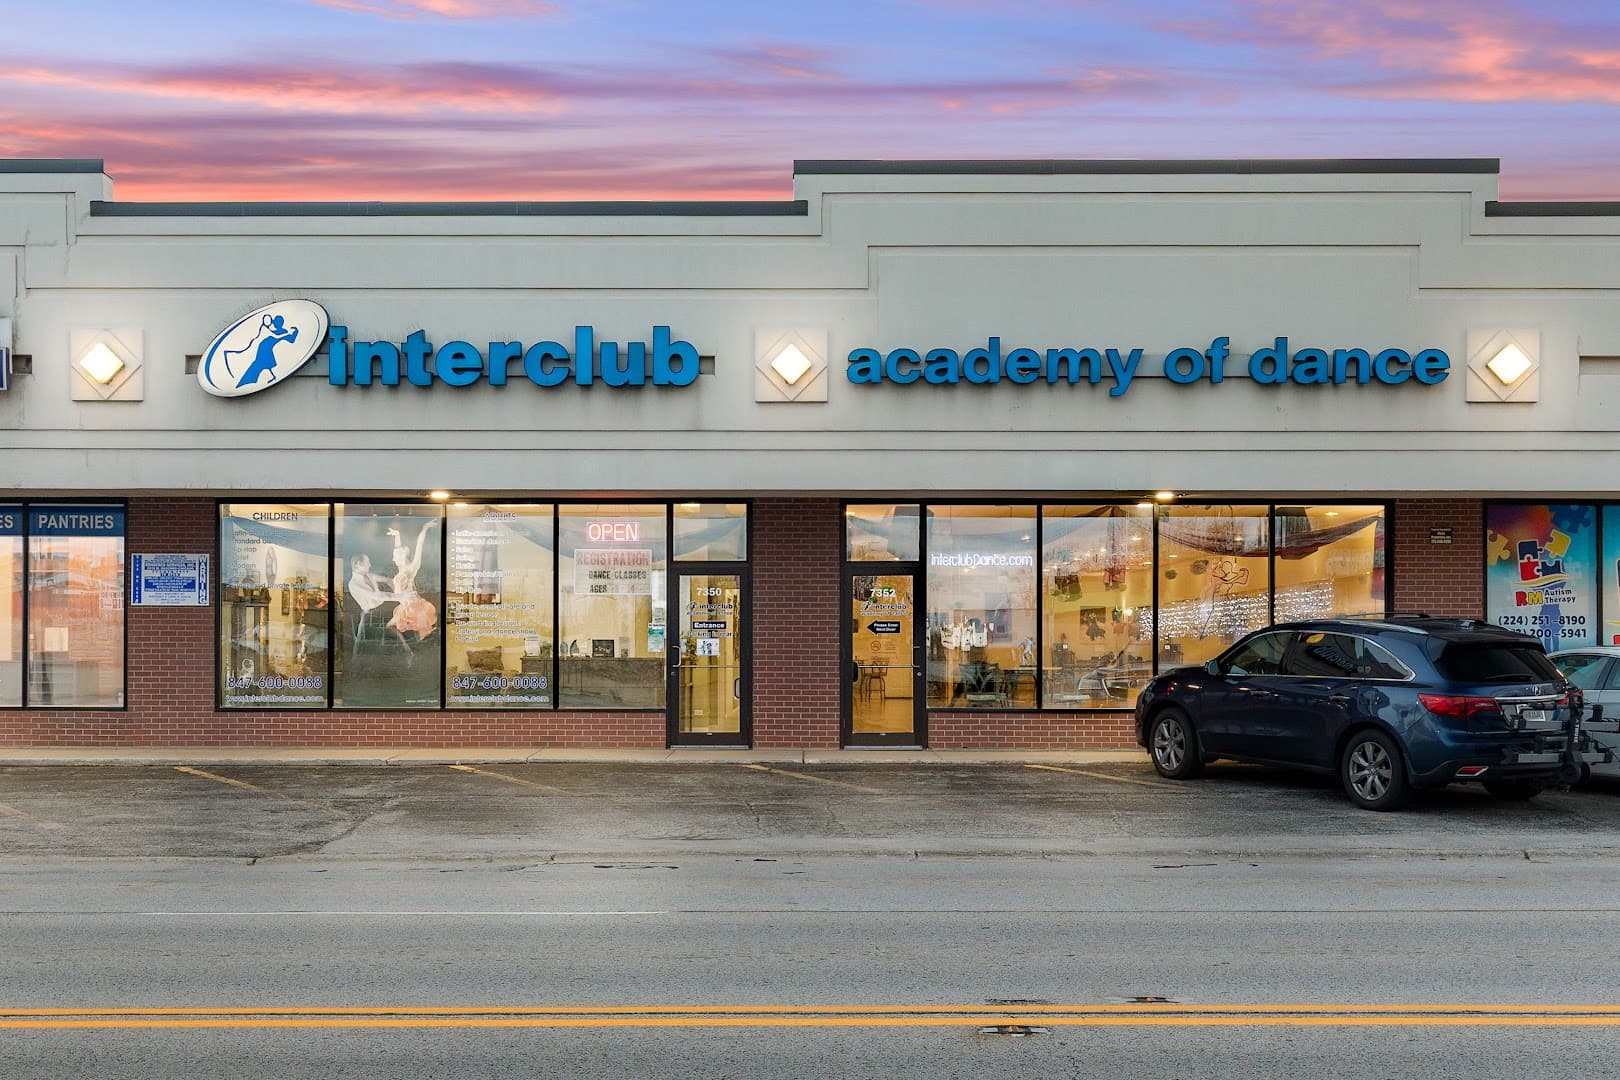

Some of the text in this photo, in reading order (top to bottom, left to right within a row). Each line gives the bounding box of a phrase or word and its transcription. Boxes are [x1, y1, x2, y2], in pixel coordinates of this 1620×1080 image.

[327, 325, 701, 387] interclub
[847, 337, 1451, 396] academy of dance
[38, 514, 114, 529] PANTRIES
[252, 512, 298, 521] CHILDREN
[588, 523, 638, 541] OPEN
[577, 551, 649, 566] REGISTRATION
[931, 553, 1033, 566] InterclubDance.com
[588, 570, 647, 580] DANCE CLASSES
[696, 587, 722, 596] 7350
[869, 588, 896, 597] 7352
[1516, 591, 1543, 606] RM
[1498, 615, 1528, 625] (224)
[228, 676, 322, 689] 847-600-0088
[453, 676, 547, 689] 847-600-0088
